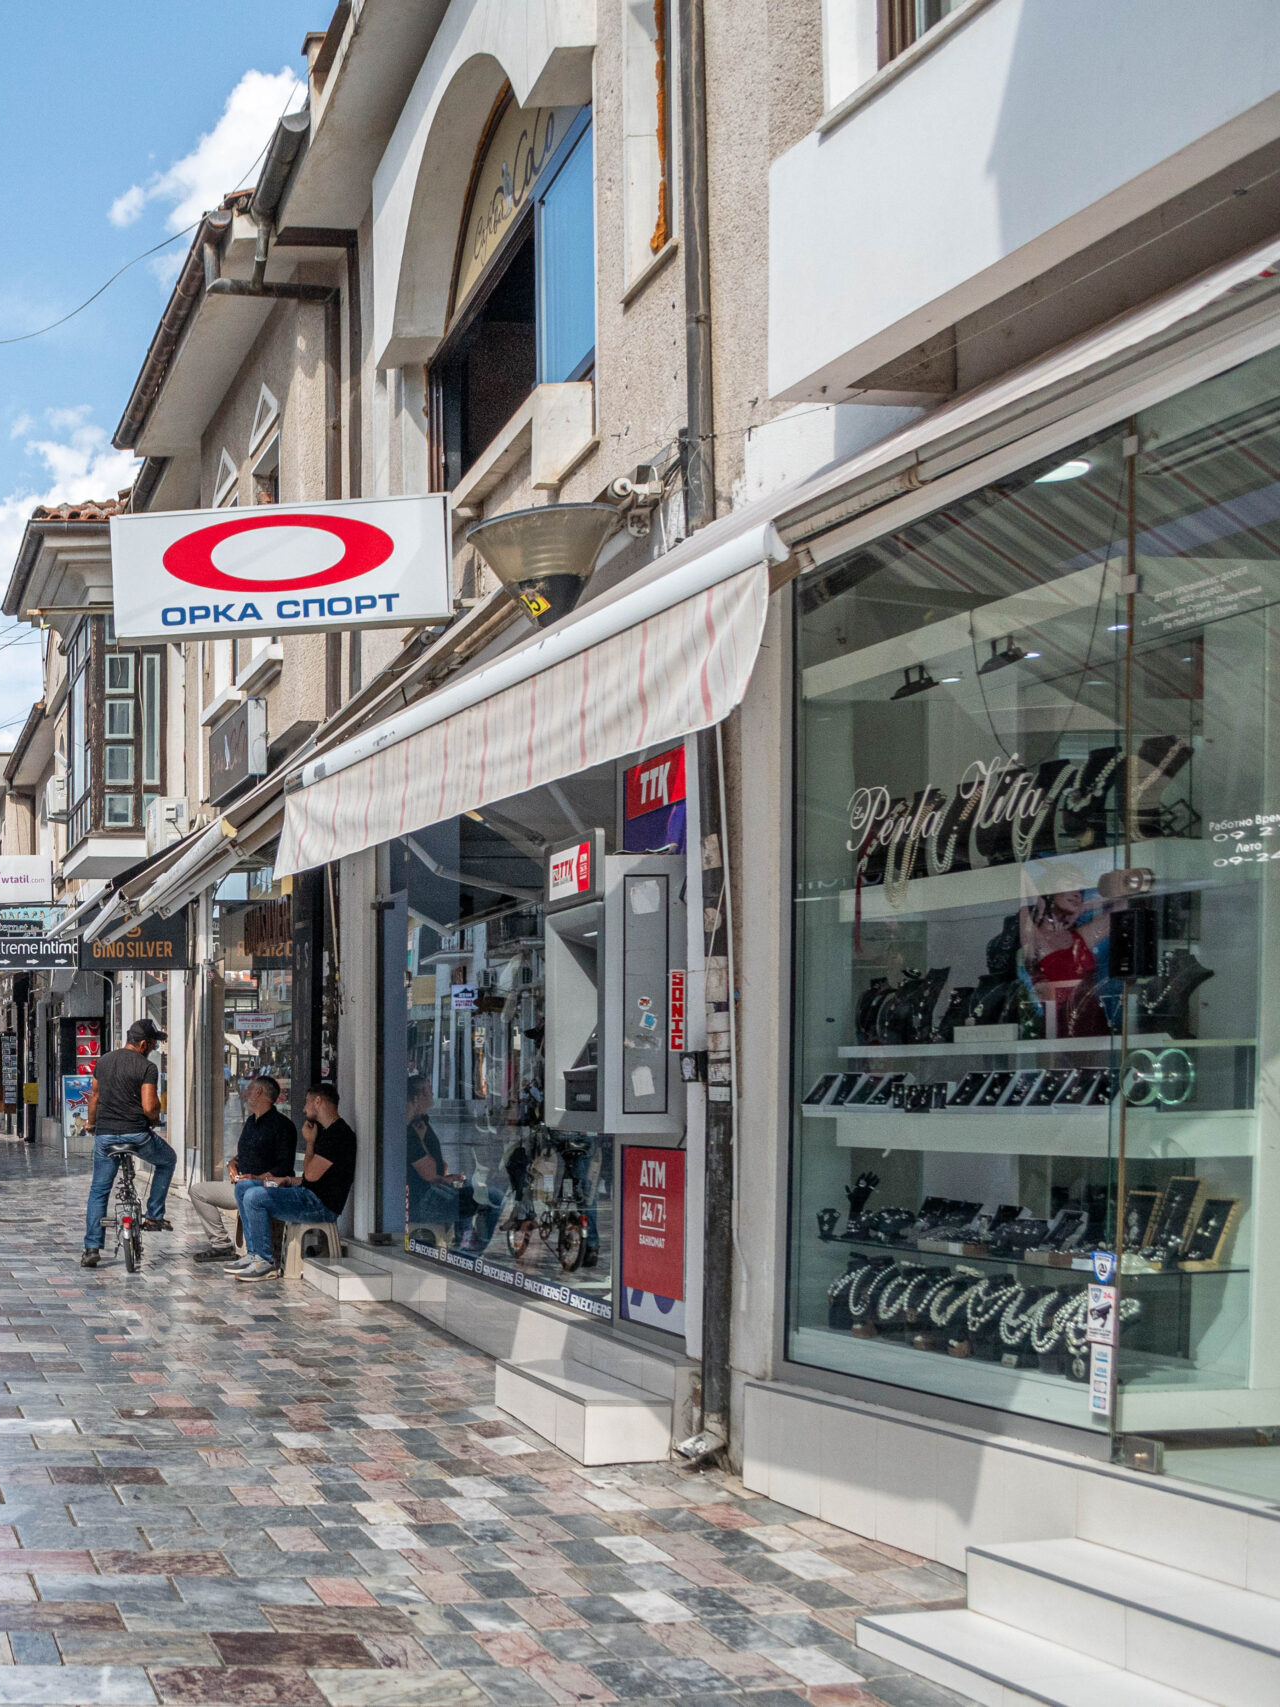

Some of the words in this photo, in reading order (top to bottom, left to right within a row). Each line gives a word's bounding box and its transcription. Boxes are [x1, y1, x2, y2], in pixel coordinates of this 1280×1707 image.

[161, 602, 263, 627] ОРКА
[276, 593, 400, 619] СПОРТ
[640, 760, 672, 806] TTK
[846, 784, 942, 852] Perla
[960, 752, 1044, 830] Vita
[1208, 818, 1253, 832] Работно
[1235, 842, 1262, 854] Лето
[93, 941, 125, 959] GINO
[126, 940, 173, 958] SILVER
[671, 971, 684, 1050] SONIC
[639, 1160, 666, 1189] ATM
[638, 1233, 666, 1249] БАНКОМАТ
[447, 1253, 475, 1271] SKECHERS
[483, 1265, 514, 1285] SKECHERS
[524, 1278, 561, 1301] SKECHERS
[570, 1293, 612, 1320] SKECHERS
